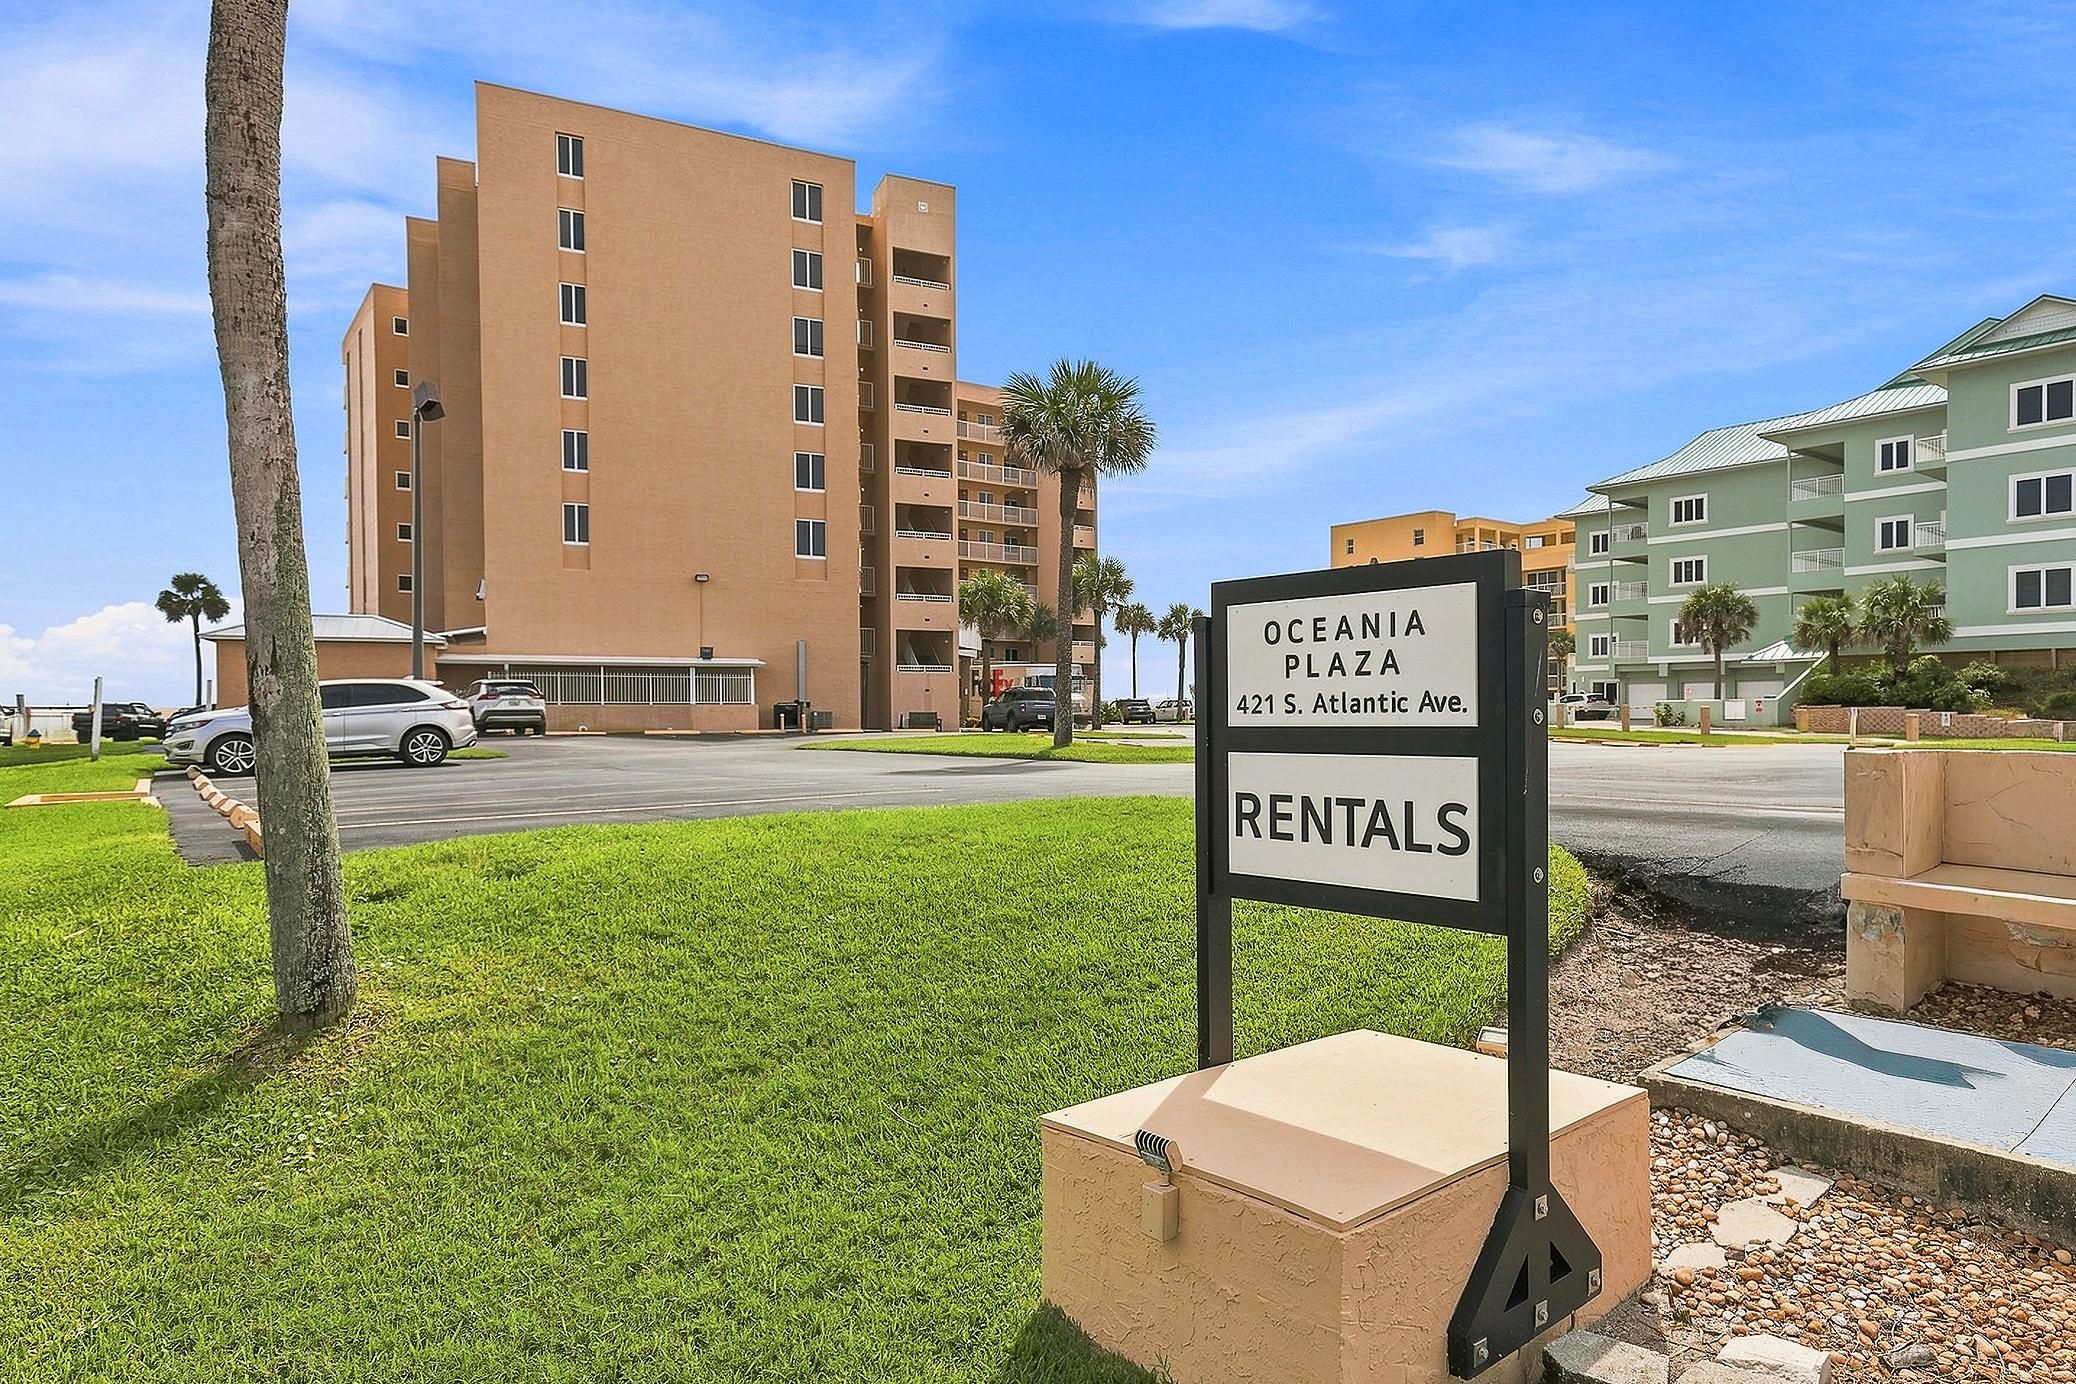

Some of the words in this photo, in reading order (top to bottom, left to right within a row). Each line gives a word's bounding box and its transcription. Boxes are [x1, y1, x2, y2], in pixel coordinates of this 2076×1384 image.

[1265, 610, 1425, 645] OCEANIA
[1285, 649, 1400, 678] PLAZA
[1236, 694, 1274, 714] 421
[1284, 694, 1303, 714] S.
[1312, 691, 1409, 714] Atlantic
[1418, 690, 1468, 714] Ave.
[1236, 792, 1470, 856] RENTALS
